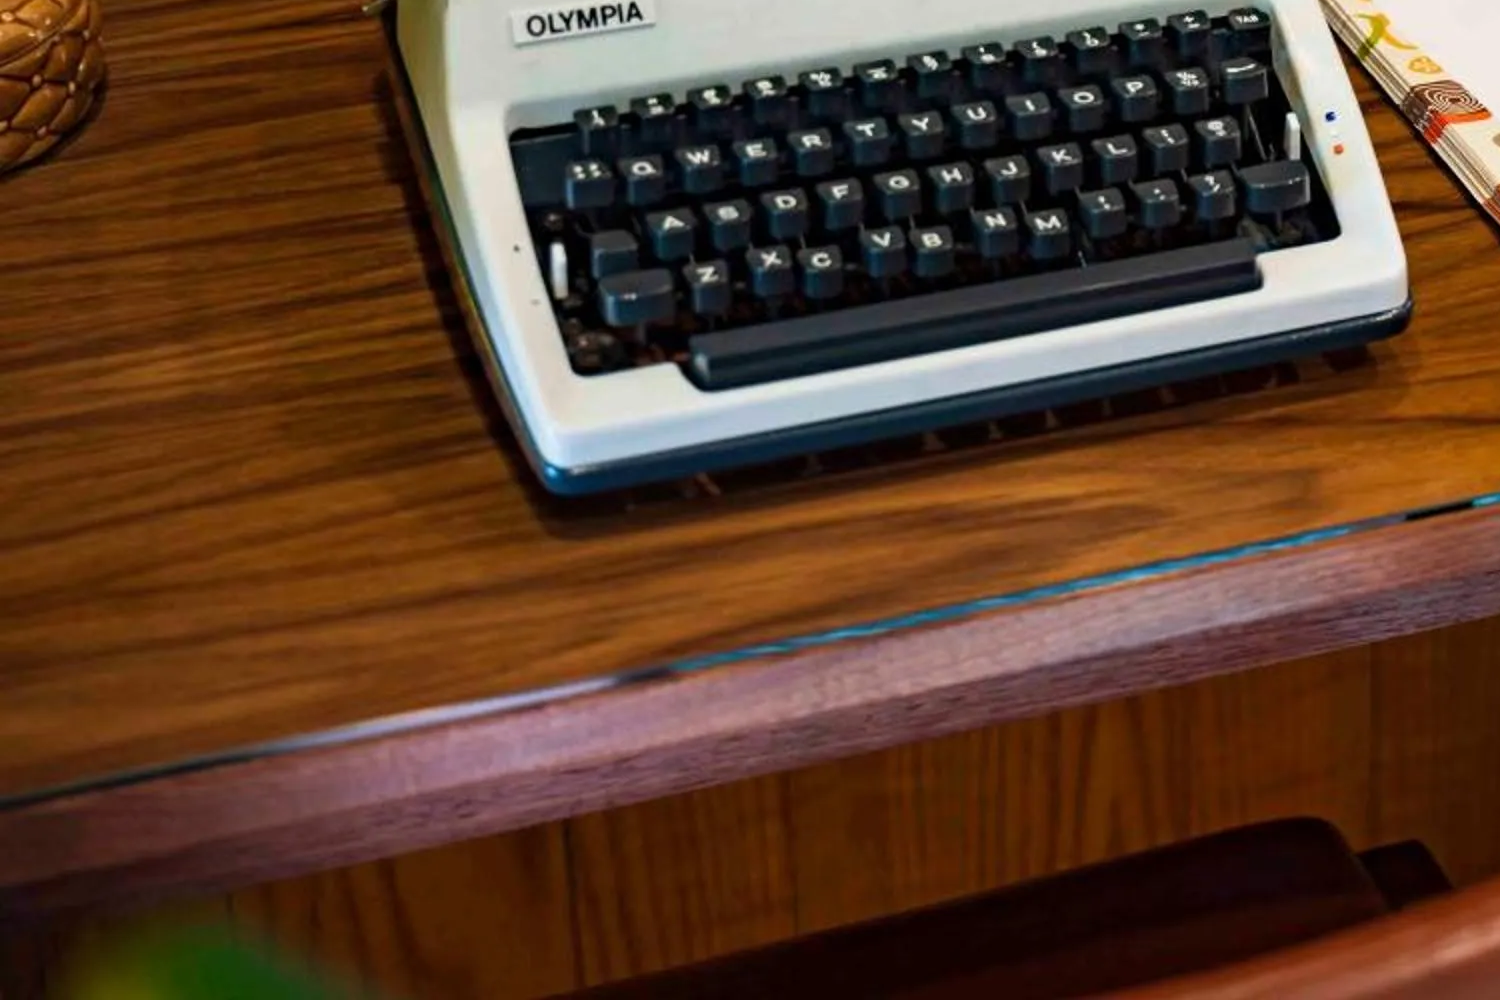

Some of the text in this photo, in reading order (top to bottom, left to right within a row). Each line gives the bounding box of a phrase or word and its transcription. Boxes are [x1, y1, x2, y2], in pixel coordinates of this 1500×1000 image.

[526, 0, 643, 37] OLYMPIA
[632, 162, 655, 175] Q
[687, 150, 709, 164] W
[745, 143, 766, 157] E
[802, 134, 822, 148] R
[856, 123, 875, 137] T
[911, 117, 929, 131] Y
[967, 107, 987, 120] U
[1073, 91, 1095, 103] O
[1126, 81, 1144, 93] P
[663, 215, 684, 230] A
[718, 206, 739, 220] S
[775, 195, 797, 209] D
[832, 184, 849, 199] F
[941, 168, 963, 183] H
[1001, 161, 1018, 175] J
[1051, 149, 1072, 162] K
[1107, 143, 1127, 155] L
[697, 213, 1061, 283] Z X C V B N M
